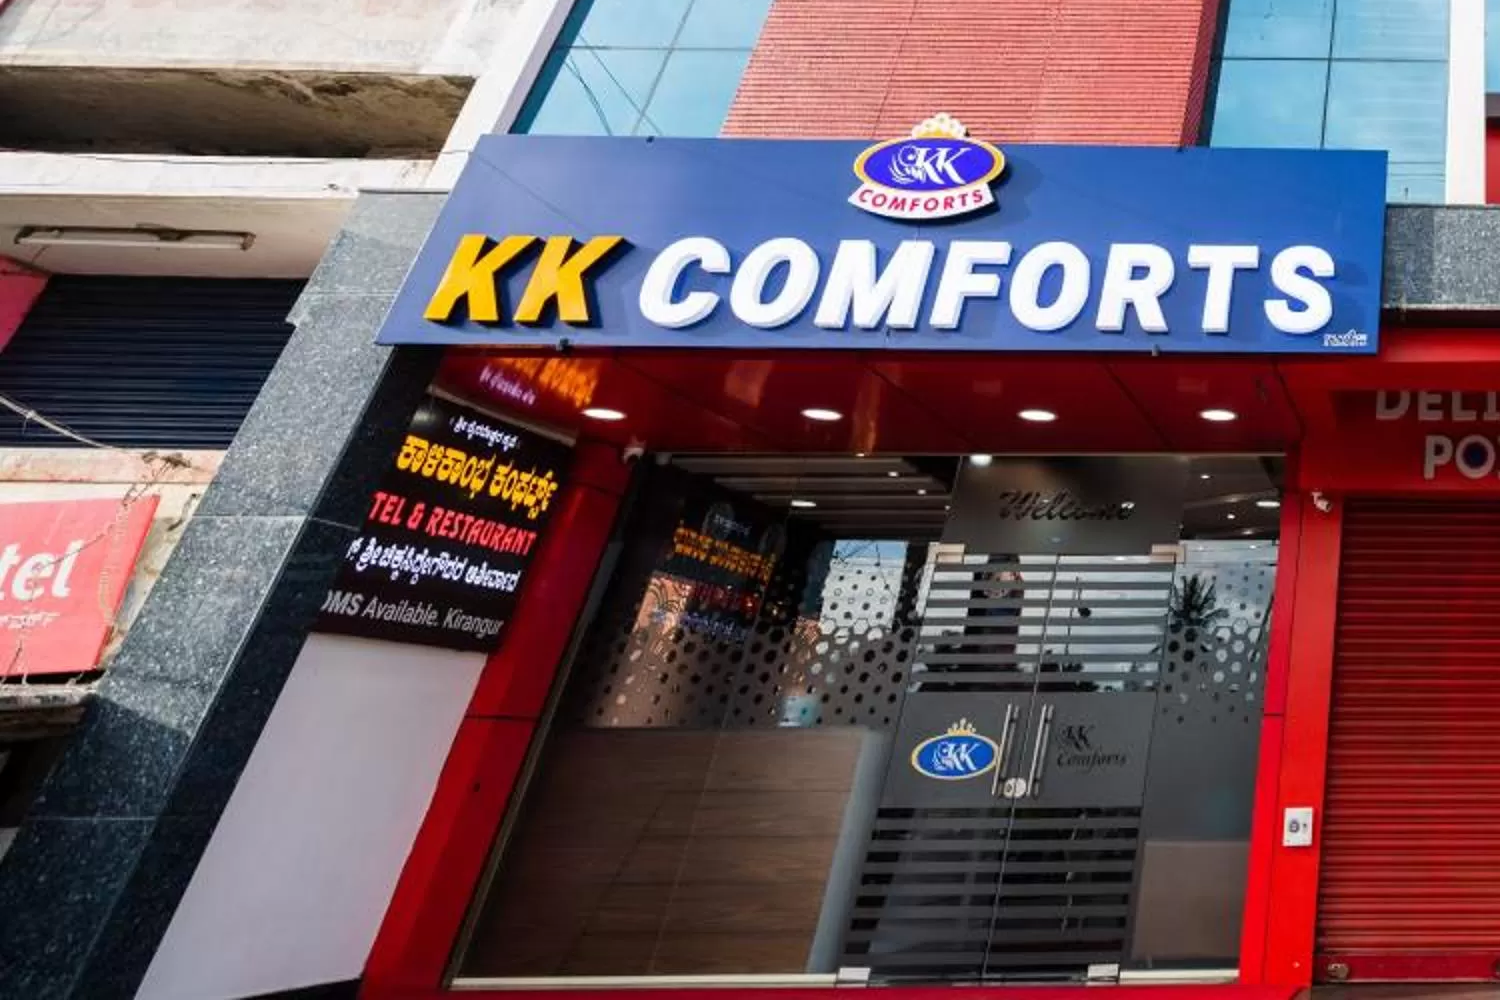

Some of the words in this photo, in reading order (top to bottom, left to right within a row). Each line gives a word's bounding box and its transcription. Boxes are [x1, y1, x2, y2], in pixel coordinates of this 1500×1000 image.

[858, 188, 984, 212] COMFORTS
[422, 233, 628, 323] KK
[638, 235, 1336, 333] COMFORTS
[368, 491, 405, 524] TEL
[407, 503, 426, 530] &
[426, 507, 538, 556] RESTAURANT
[0, 539, 85, 601] tel
[442, 607, 505, 640] Kirangur
